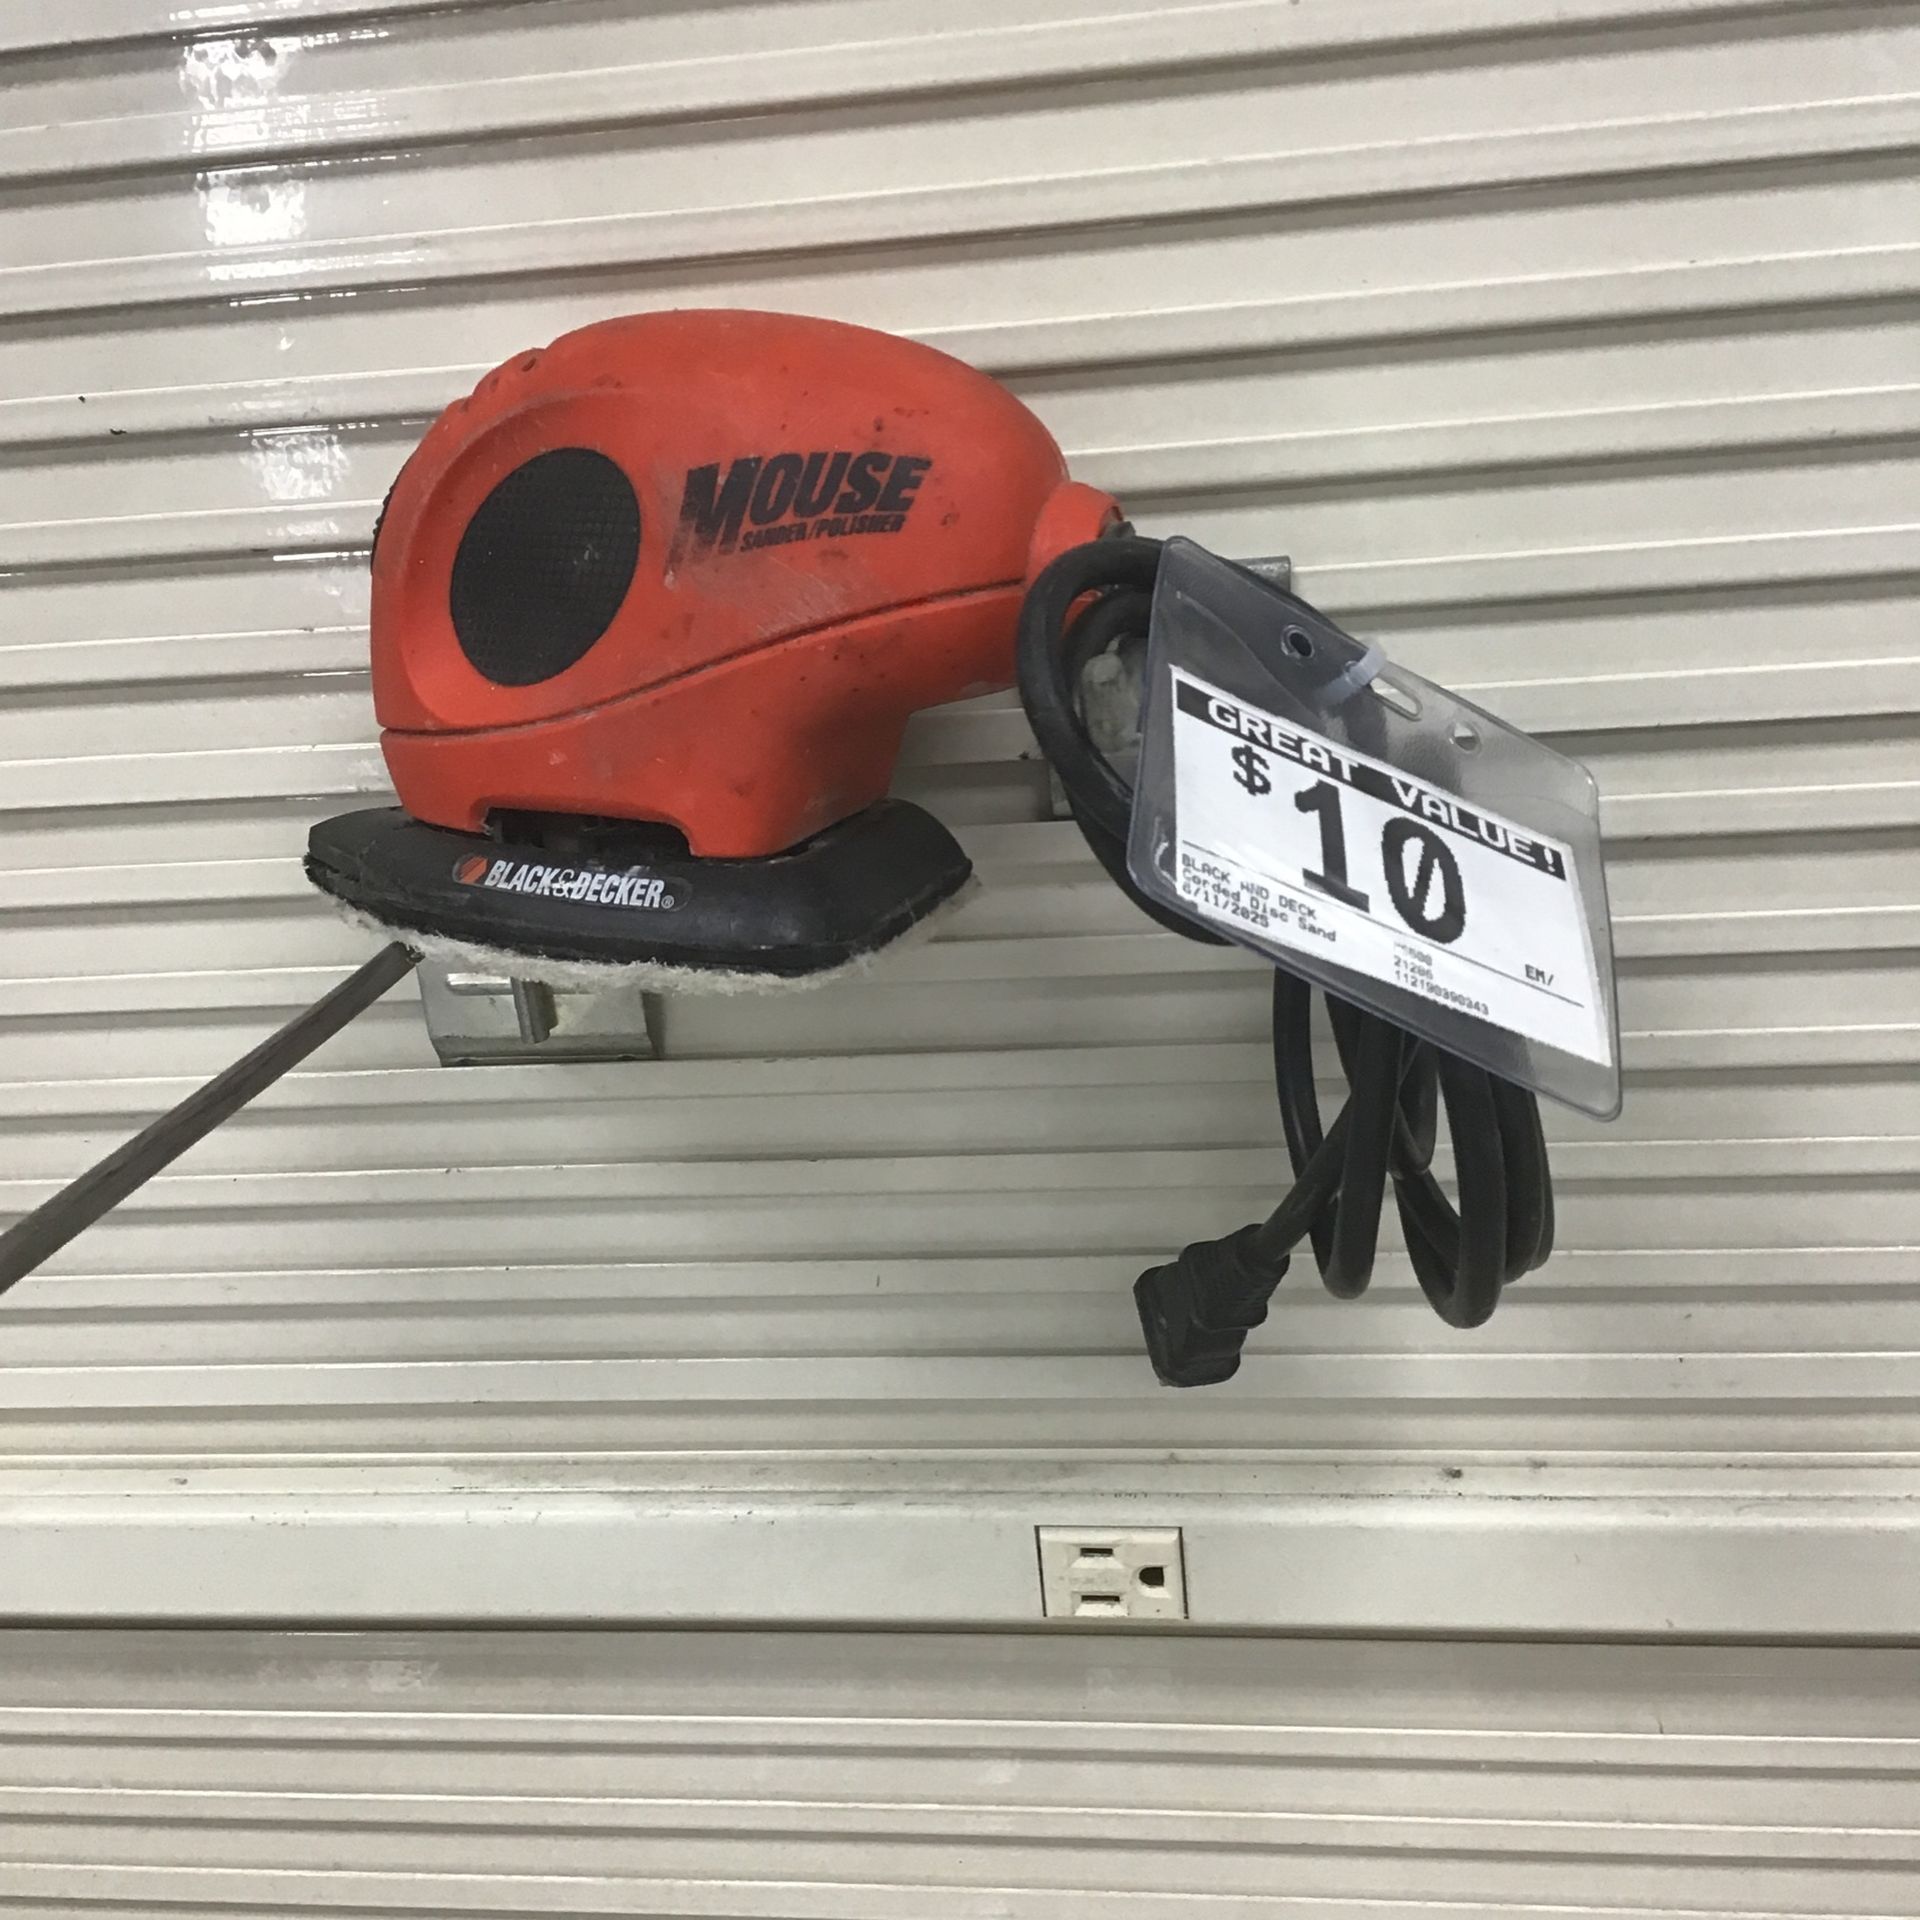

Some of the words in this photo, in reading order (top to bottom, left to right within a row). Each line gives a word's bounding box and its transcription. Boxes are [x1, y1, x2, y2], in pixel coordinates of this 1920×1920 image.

[667, 452, 933, 564] MOUSE
[740, 514, 906, 552] SANDER/POLISHER
[1208, 698, 1359, 781] GREAT
[1391, 777, 1556, 873] VALUE!
[1182, 853, 1231, 883] BLACK
[1240, 881, 1269, 900] AND
[1278, 895, 1317, 920] DECK
[1182, 868, 1241, 902] Corded
[1250, 896, 1288, 922] Disc
[1298, 916, 1337, 942] Sand
[1182, 882, 1270, 928] 6/11/2025
[1525, 963, 1554, 986] EM/
